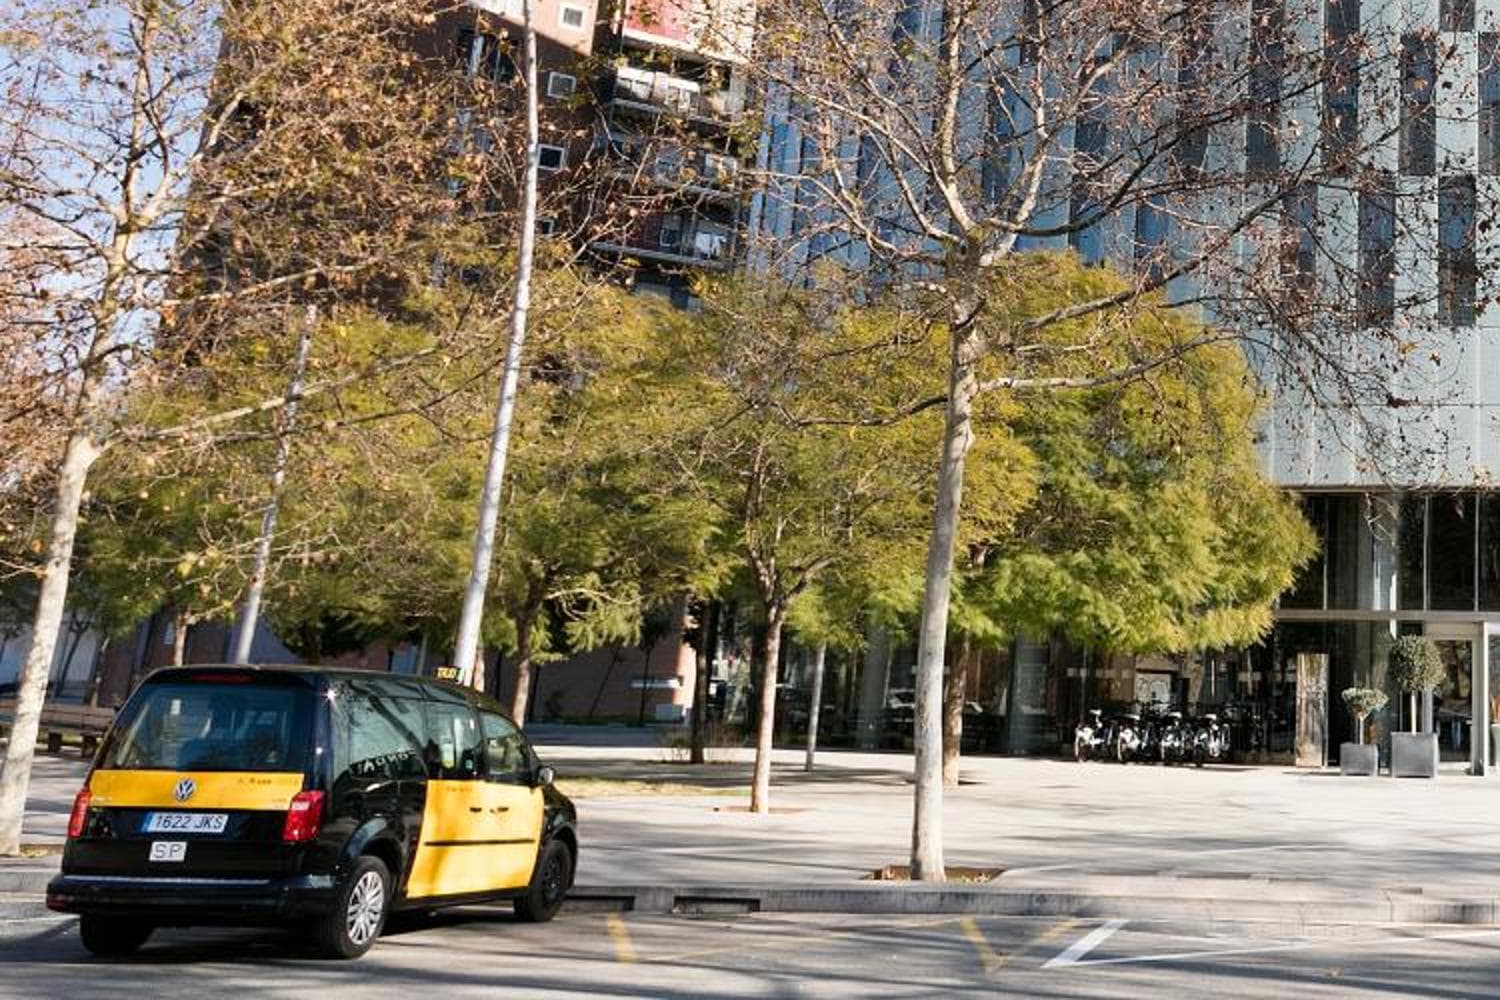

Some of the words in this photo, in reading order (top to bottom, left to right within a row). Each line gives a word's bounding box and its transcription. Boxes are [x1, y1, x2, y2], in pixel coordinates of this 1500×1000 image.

[156, 815, 192, 829] 1622
[194, 815, 224, 830] JKS
[153, 843, 183, 859] SP
